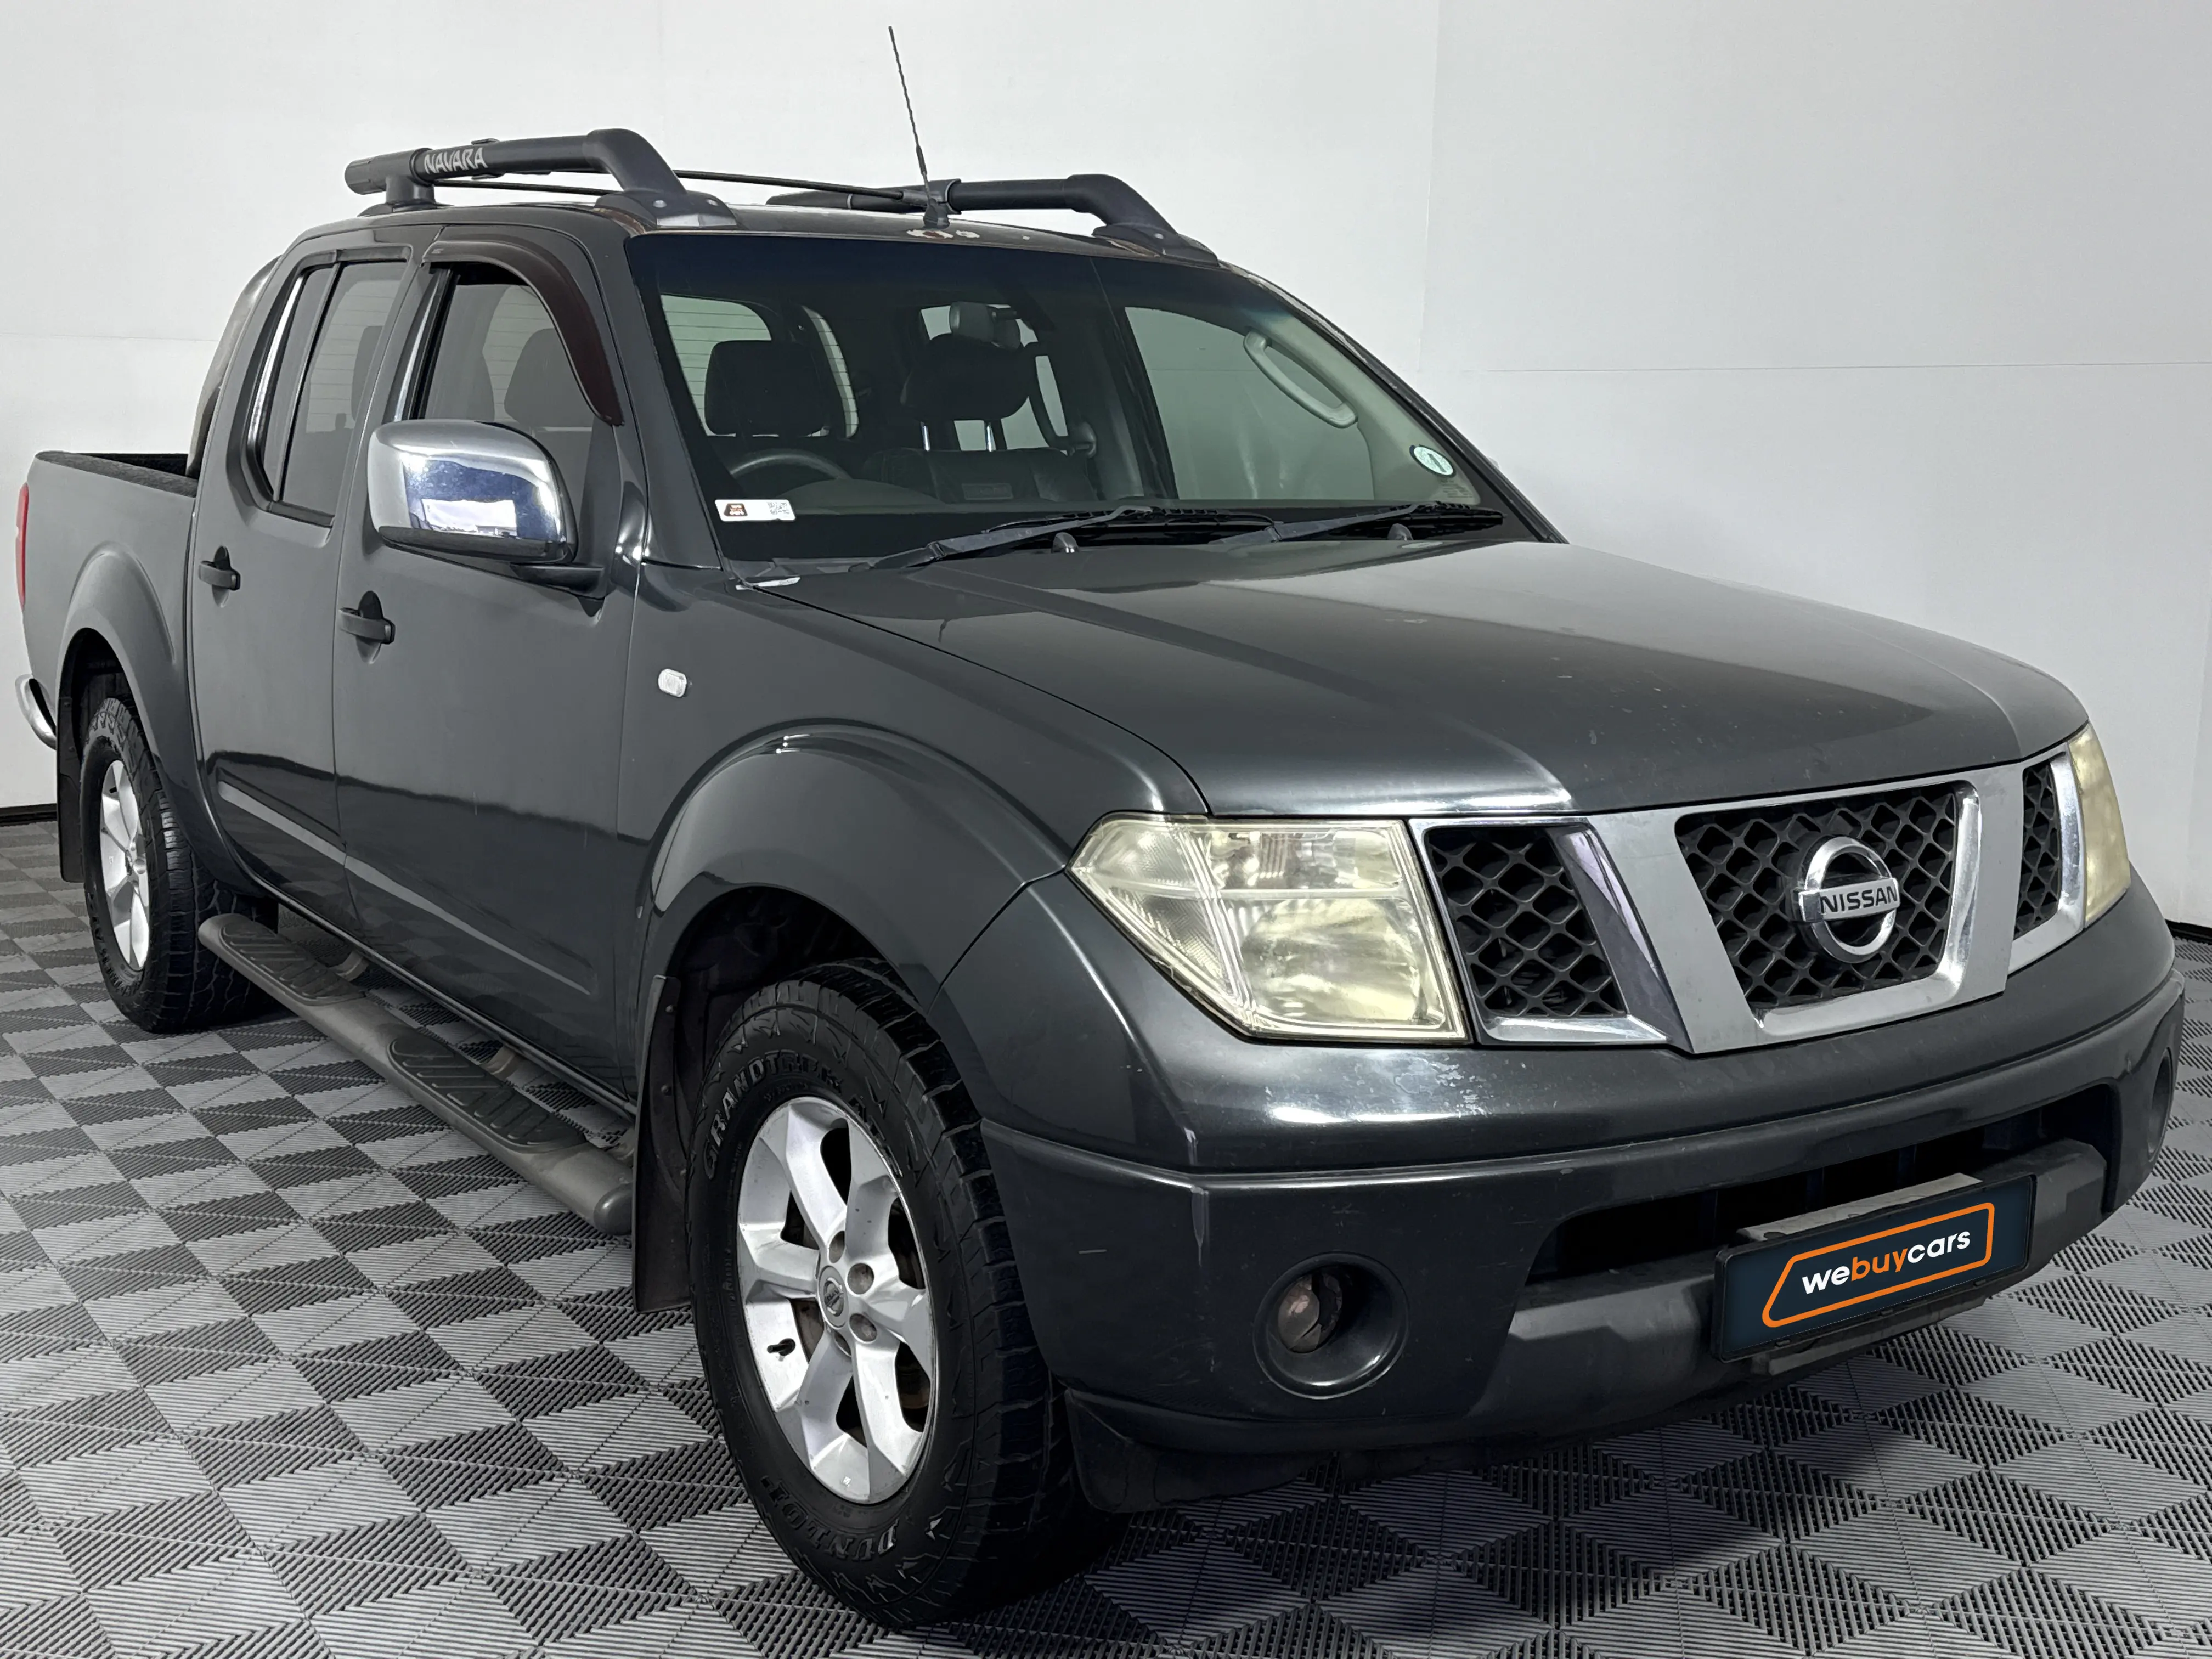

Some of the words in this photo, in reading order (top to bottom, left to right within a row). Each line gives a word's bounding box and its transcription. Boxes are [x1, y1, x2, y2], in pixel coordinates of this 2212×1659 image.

[424, 147, 488, 174] NAVARA
[1820, 885, 1897, 914] NISSAN
[1802, 1231, 1971, 1295] webuycars
